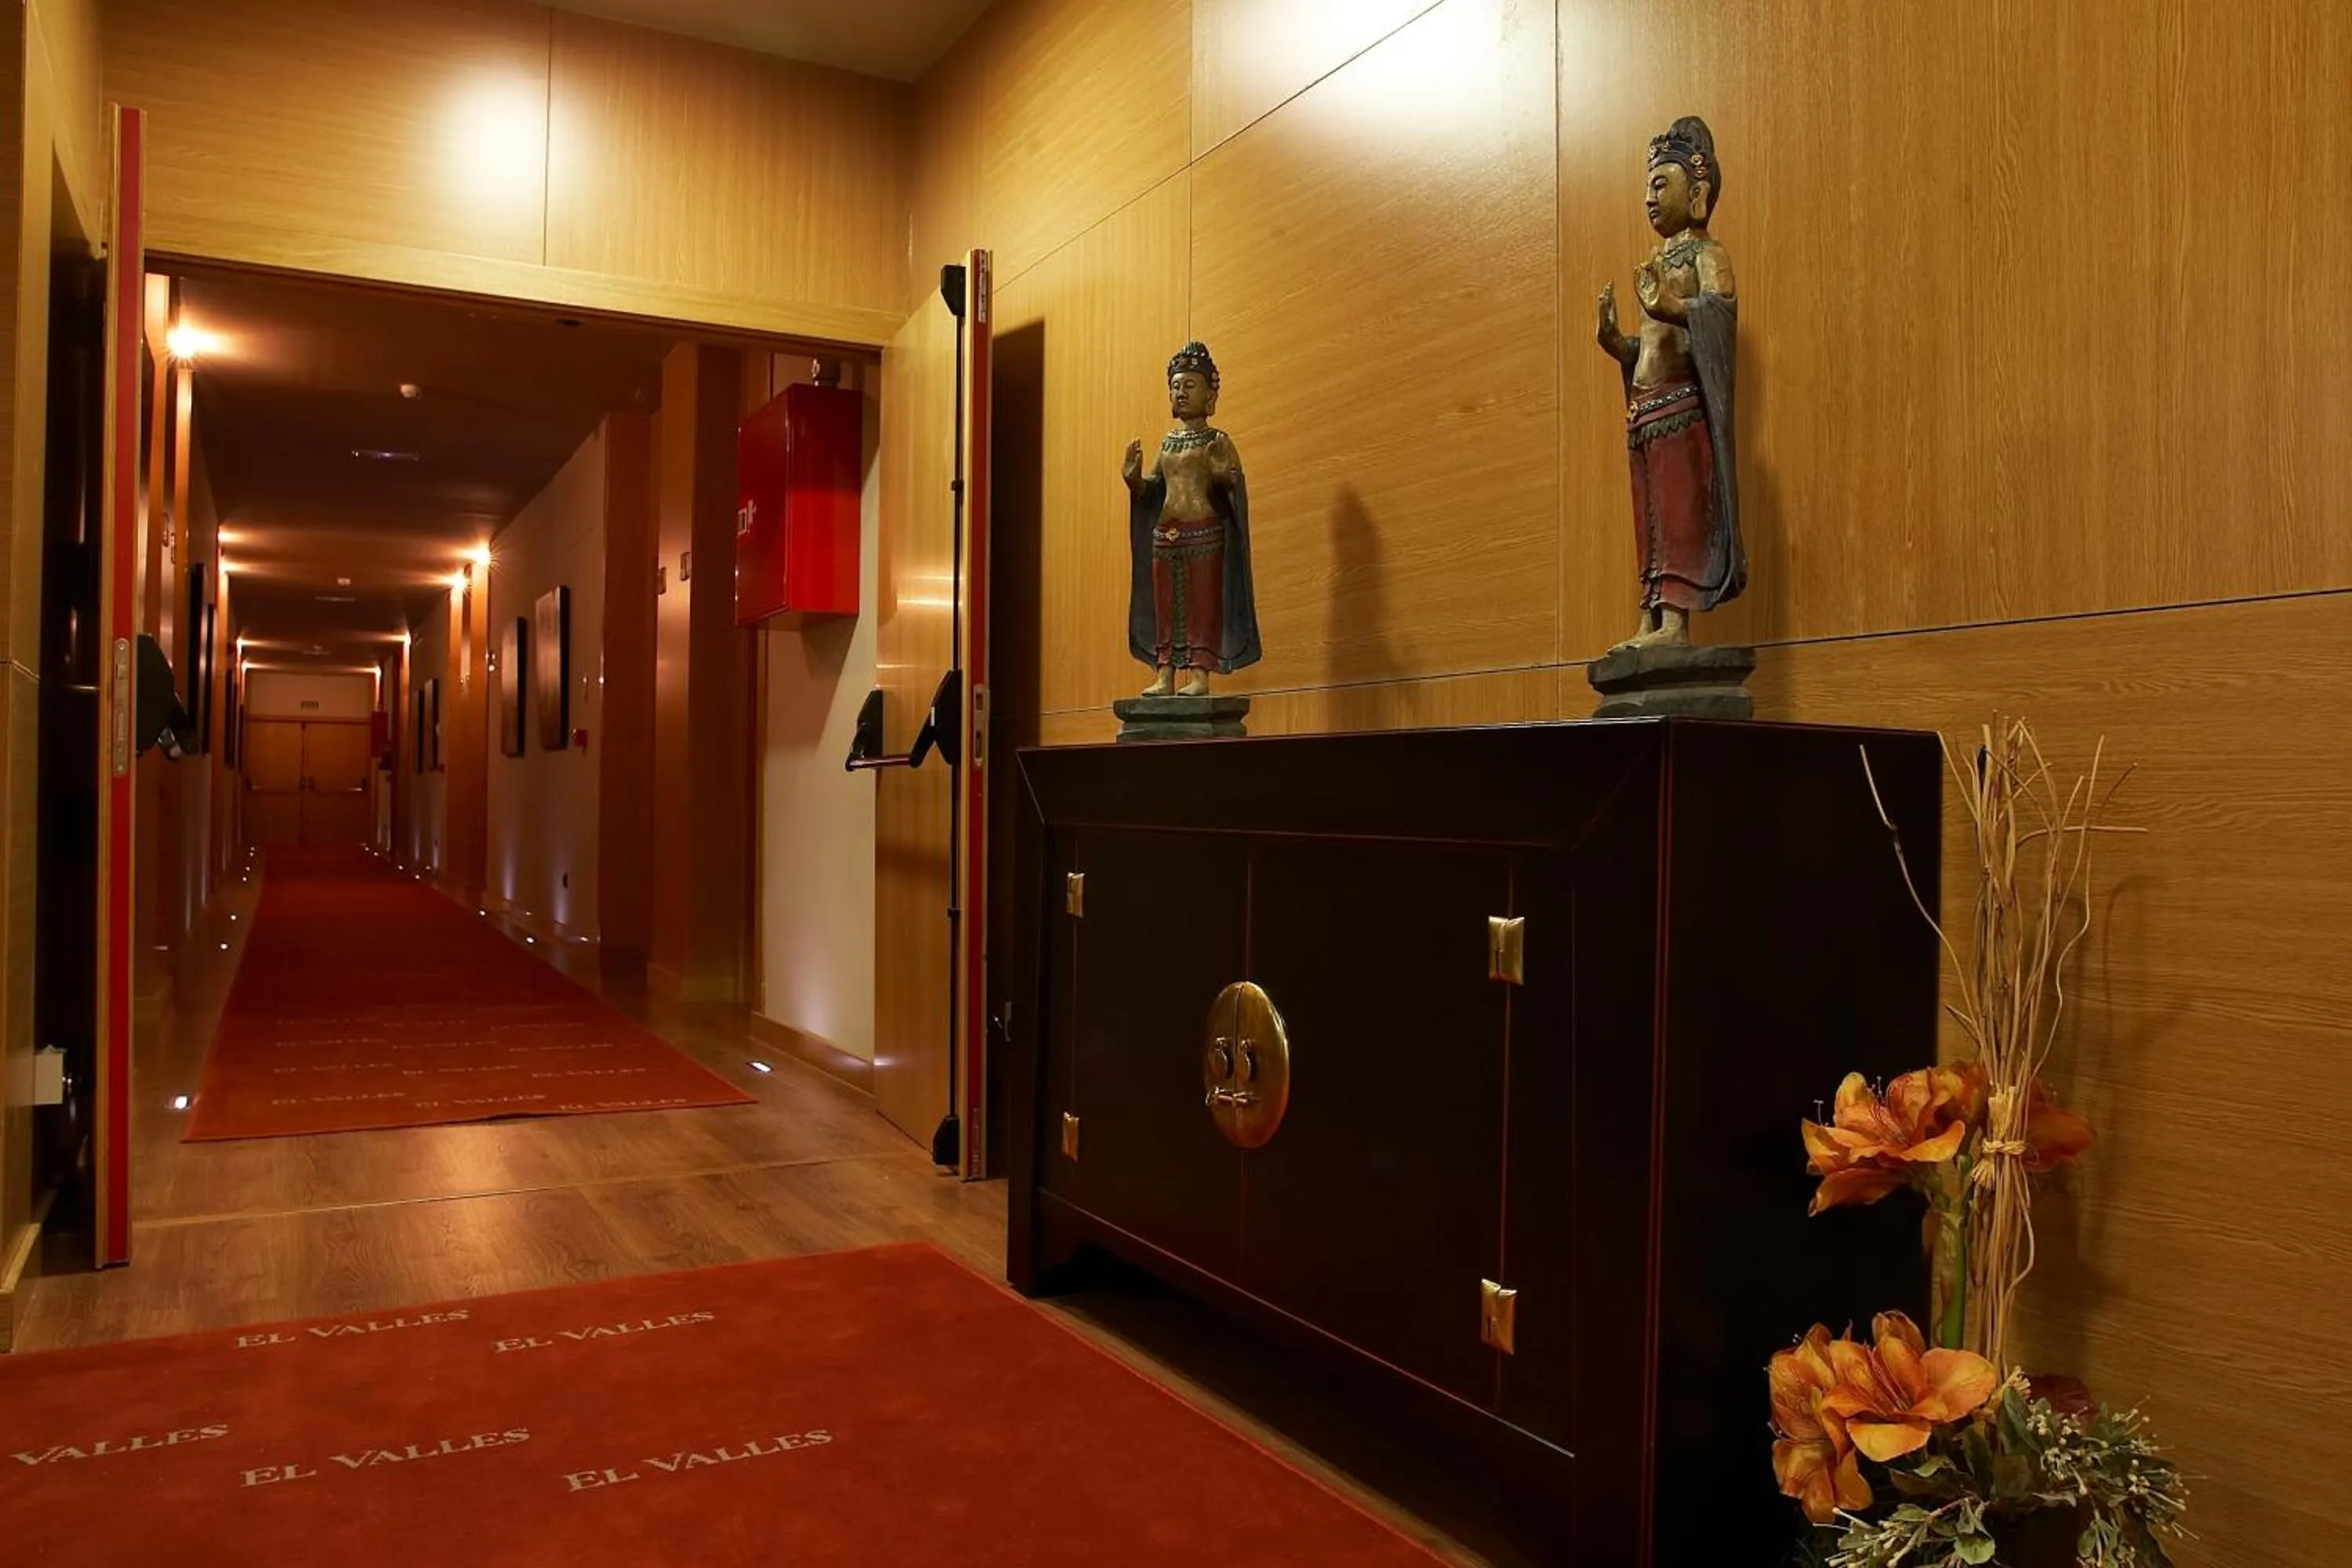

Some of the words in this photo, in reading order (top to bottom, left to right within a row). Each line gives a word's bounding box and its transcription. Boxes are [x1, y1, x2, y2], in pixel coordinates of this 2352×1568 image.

[238, 1334, 297, 1348] EL
[308, 1309, 470, 1338] VALLES
[492, 1337, 554, 1354] EL
[555, 1311, 715, 1341] VALLES
[9, 1424, 229, 1466] VALLES
[239, 1464, 318, 1488] EL
[328, 1428, 532, 1469] VALLES
[562, 1467, 640, 1492] EL
[641, 1429, 833, 1472] VALLES
